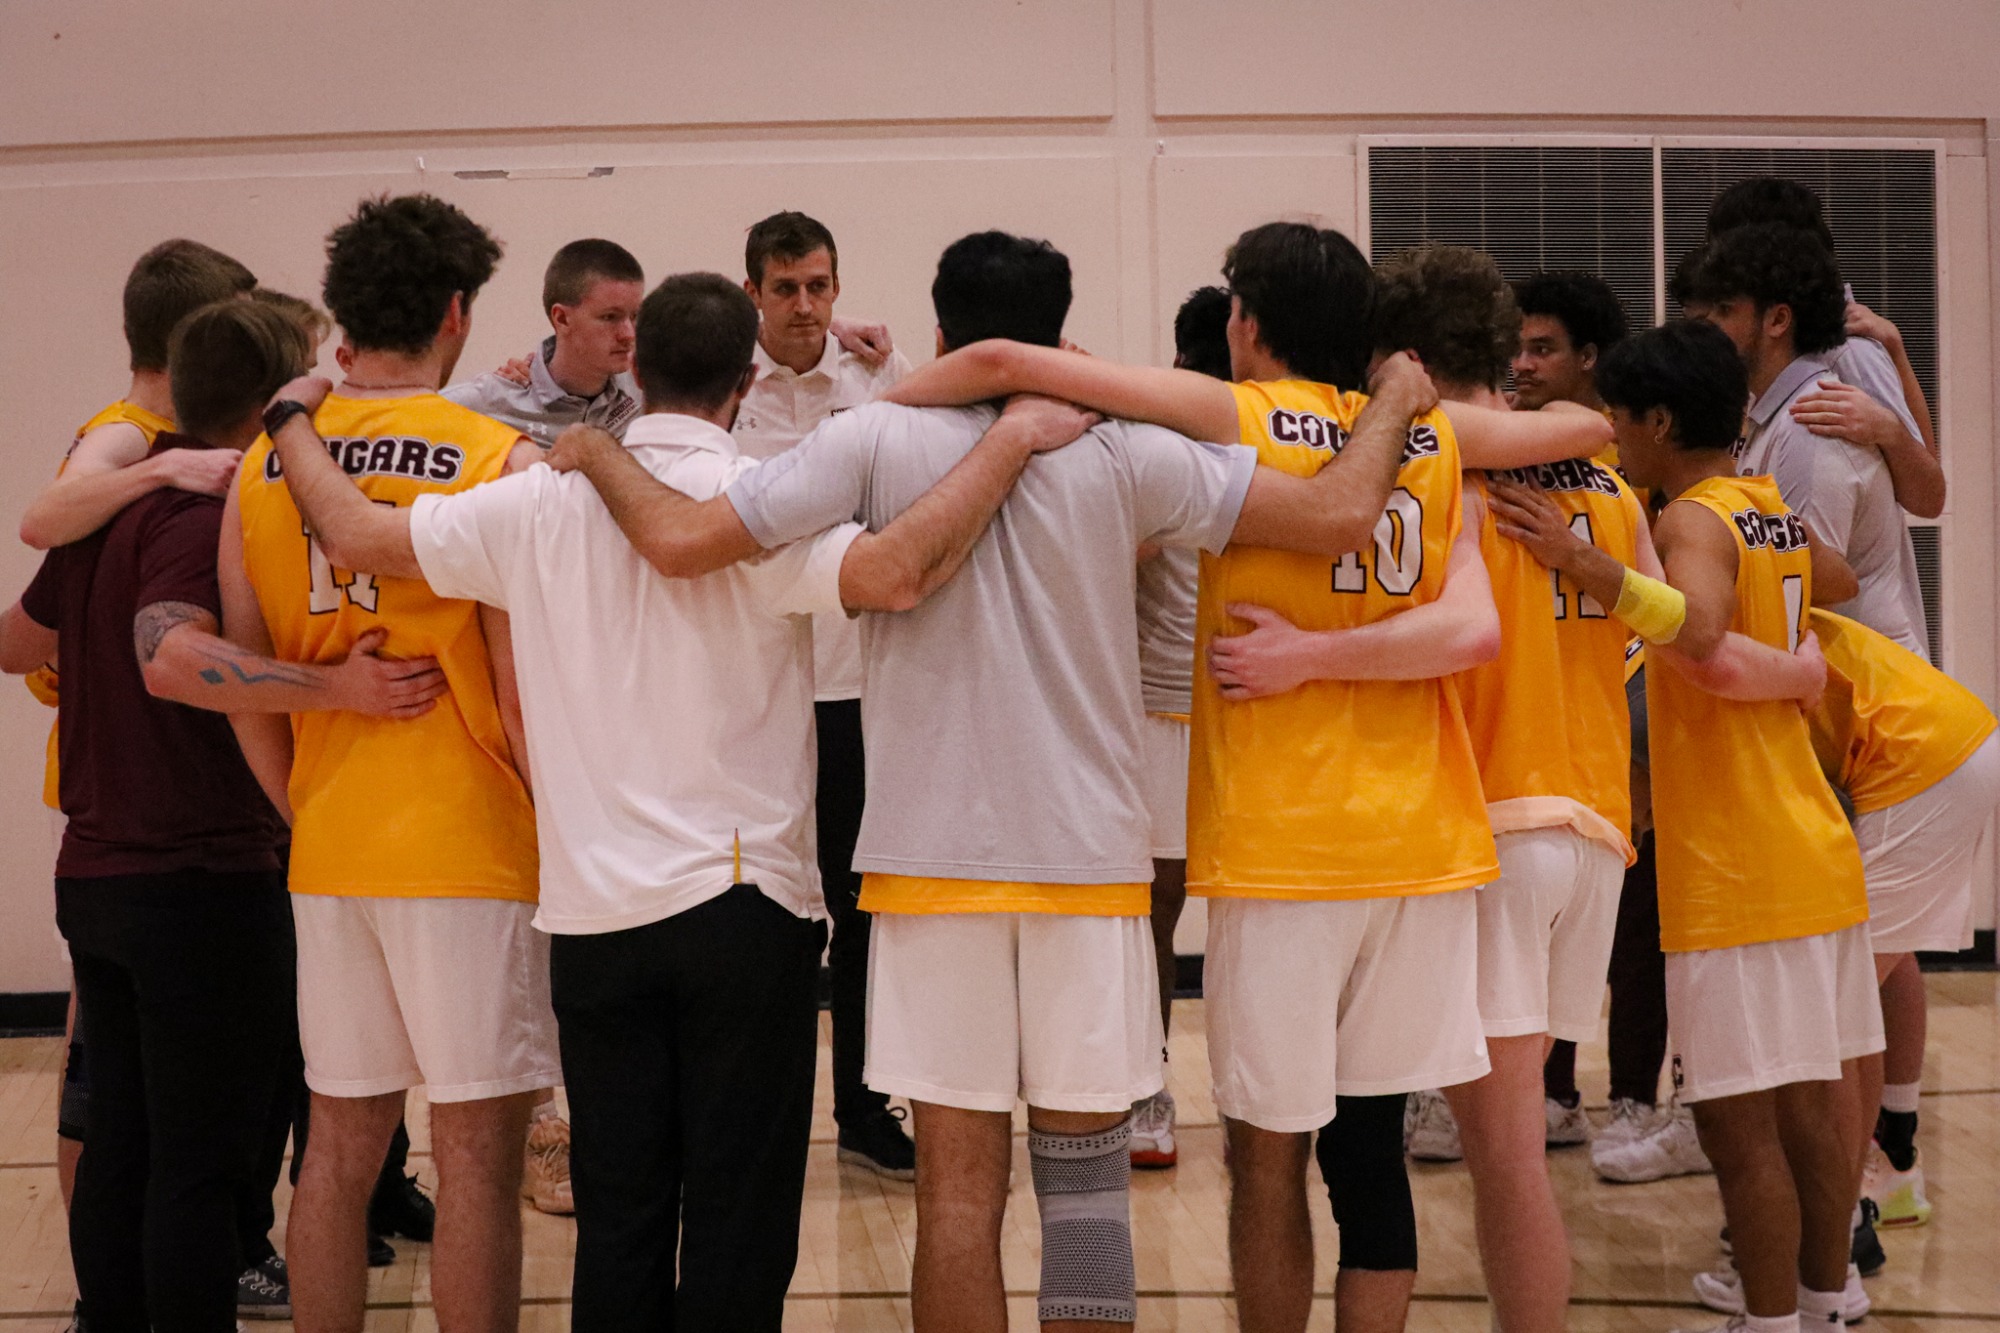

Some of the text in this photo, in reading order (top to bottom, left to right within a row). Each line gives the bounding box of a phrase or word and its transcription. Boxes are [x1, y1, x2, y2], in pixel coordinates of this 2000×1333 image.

[264, 435, 465, 484] CGARS
[1268, 407, 1441, 467] COUS
[1485, 457, 1621, 498] GARS
[302, 499, 397, 615] 1
[1549, 512, 1608, 620] 1
